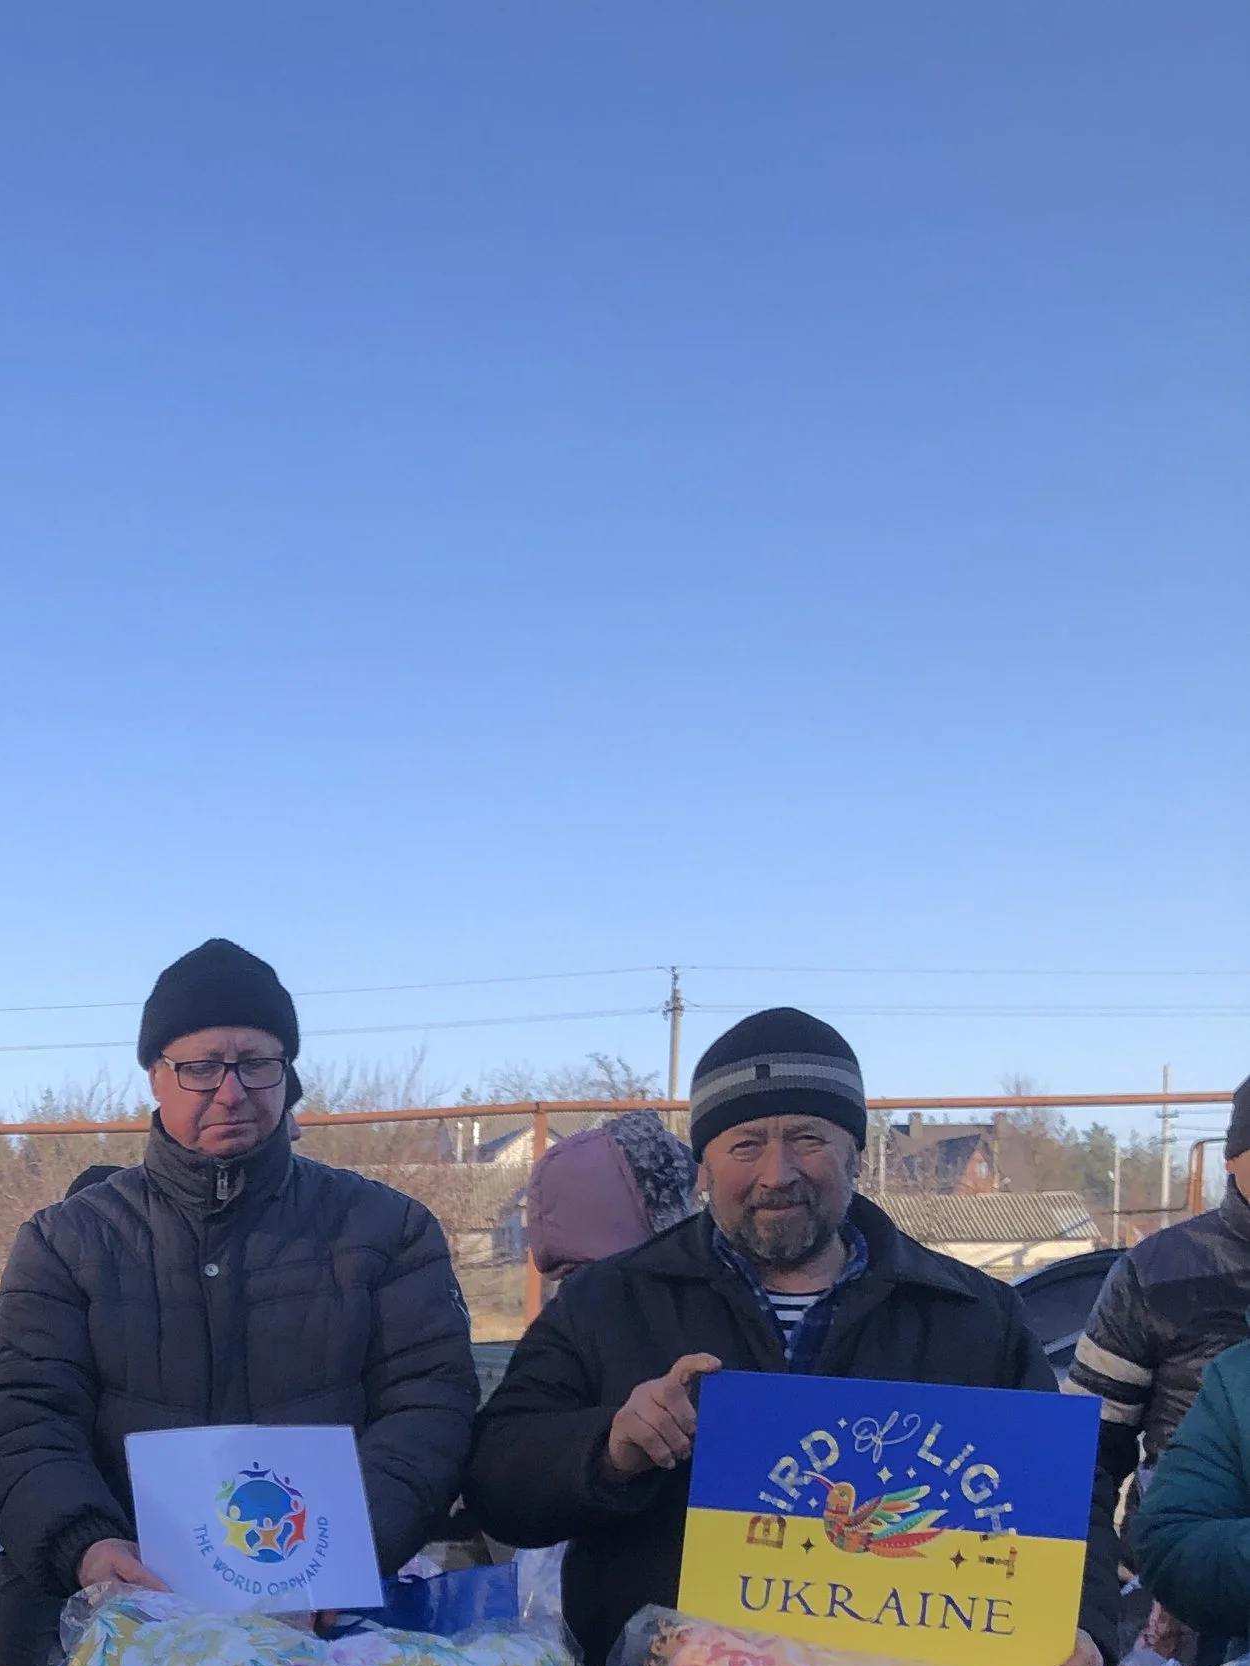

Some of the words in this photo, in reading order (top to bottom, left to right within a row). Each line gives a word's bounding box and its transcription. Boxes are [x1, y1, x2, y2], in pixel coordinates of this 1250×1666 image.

[746, 1429, 840, 1550] BIRD
[193, 1523, 214, 1557] THE
[212, 1556, 262, 1595] WORLD
[267, 1557, 322, 1595] ORPHAN
[317, 1516, 330, 1558] FUND
[738, 1574, 1015, 1635] UKRAINE
